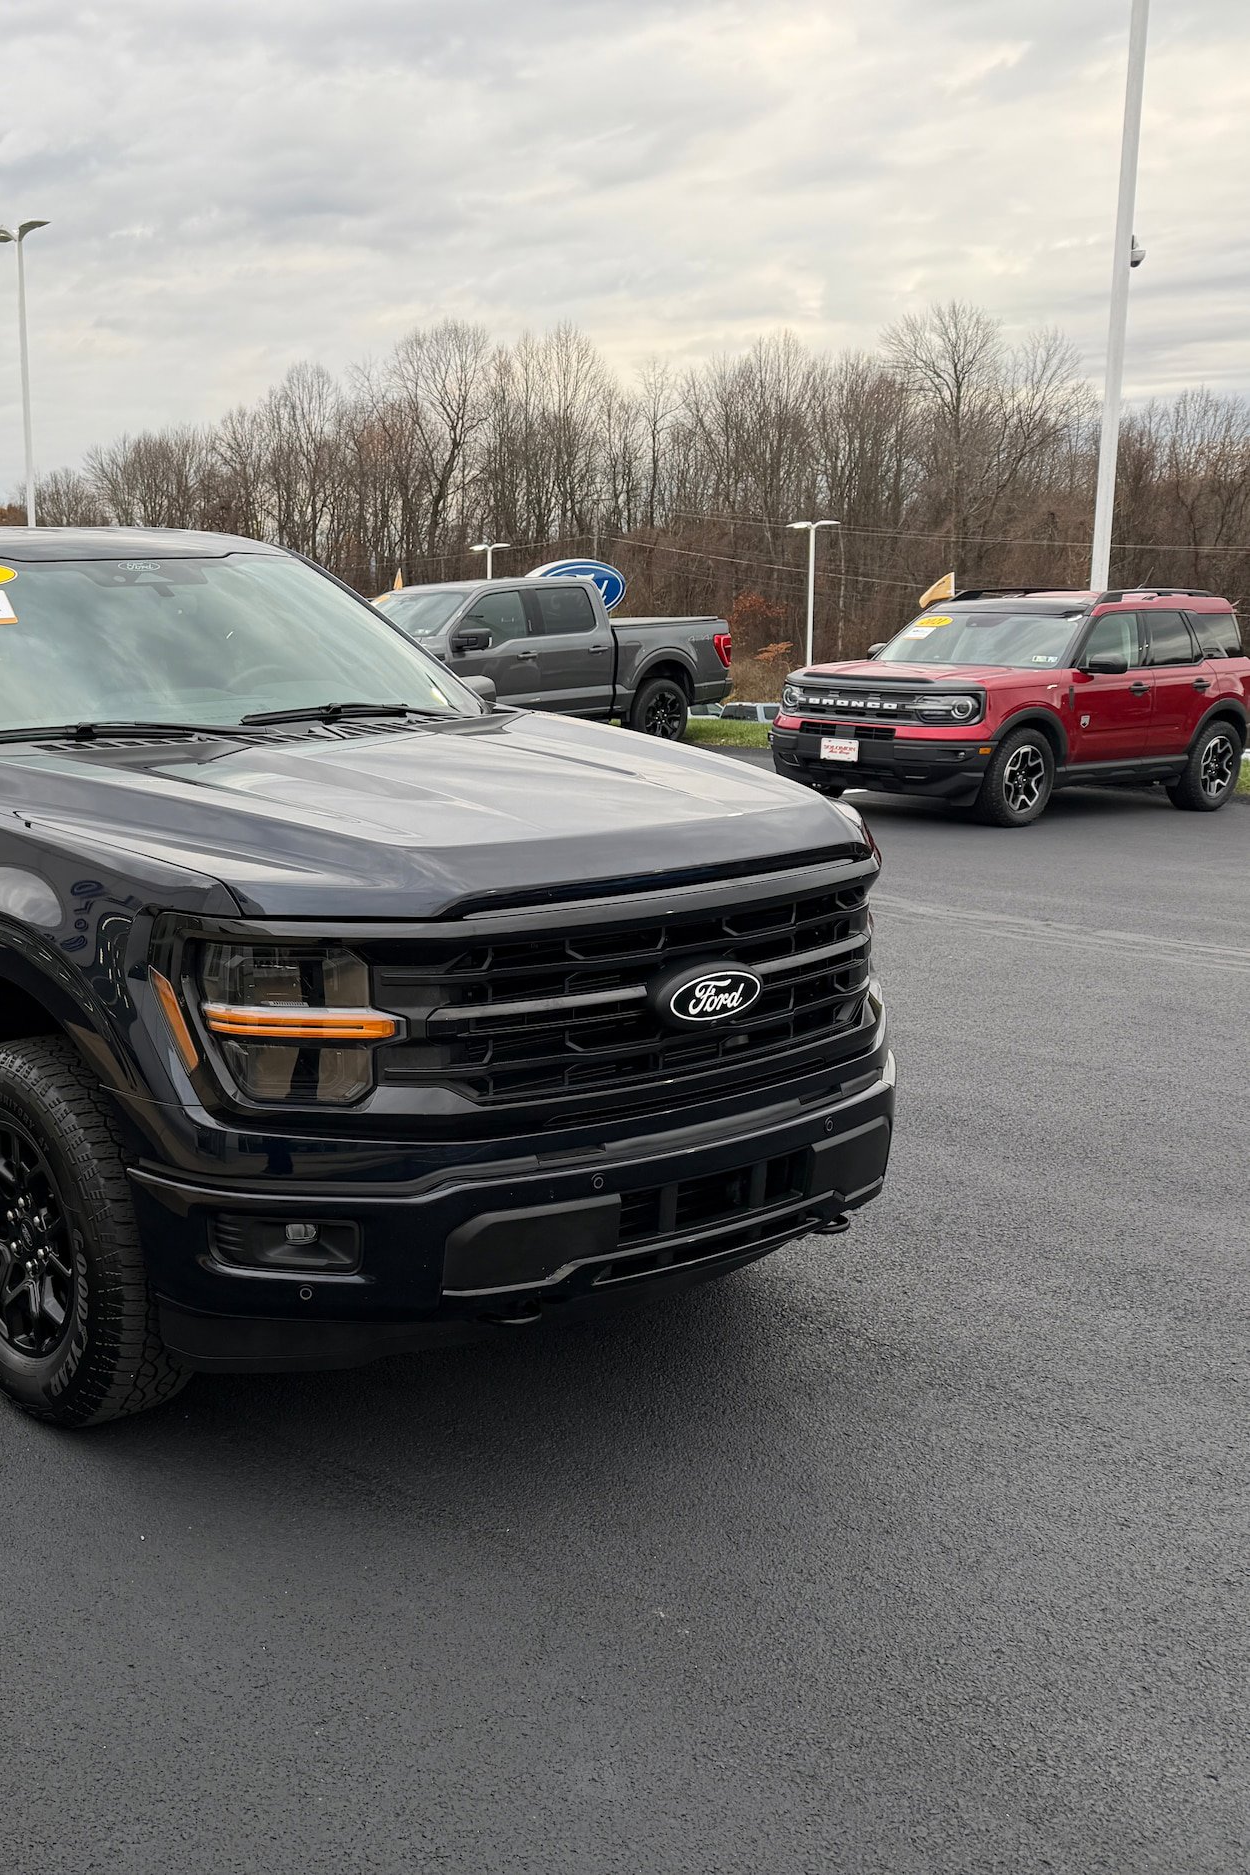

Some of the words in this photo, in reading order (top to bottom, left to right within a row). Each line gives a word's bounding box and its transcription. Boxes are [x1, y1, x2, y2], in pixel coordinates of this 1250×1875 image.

[808, 698, 898, 709] BRONCO
[688, 978, 745, 1015] Ford
[50, 1227, 90, 1398] GOODYEAR
